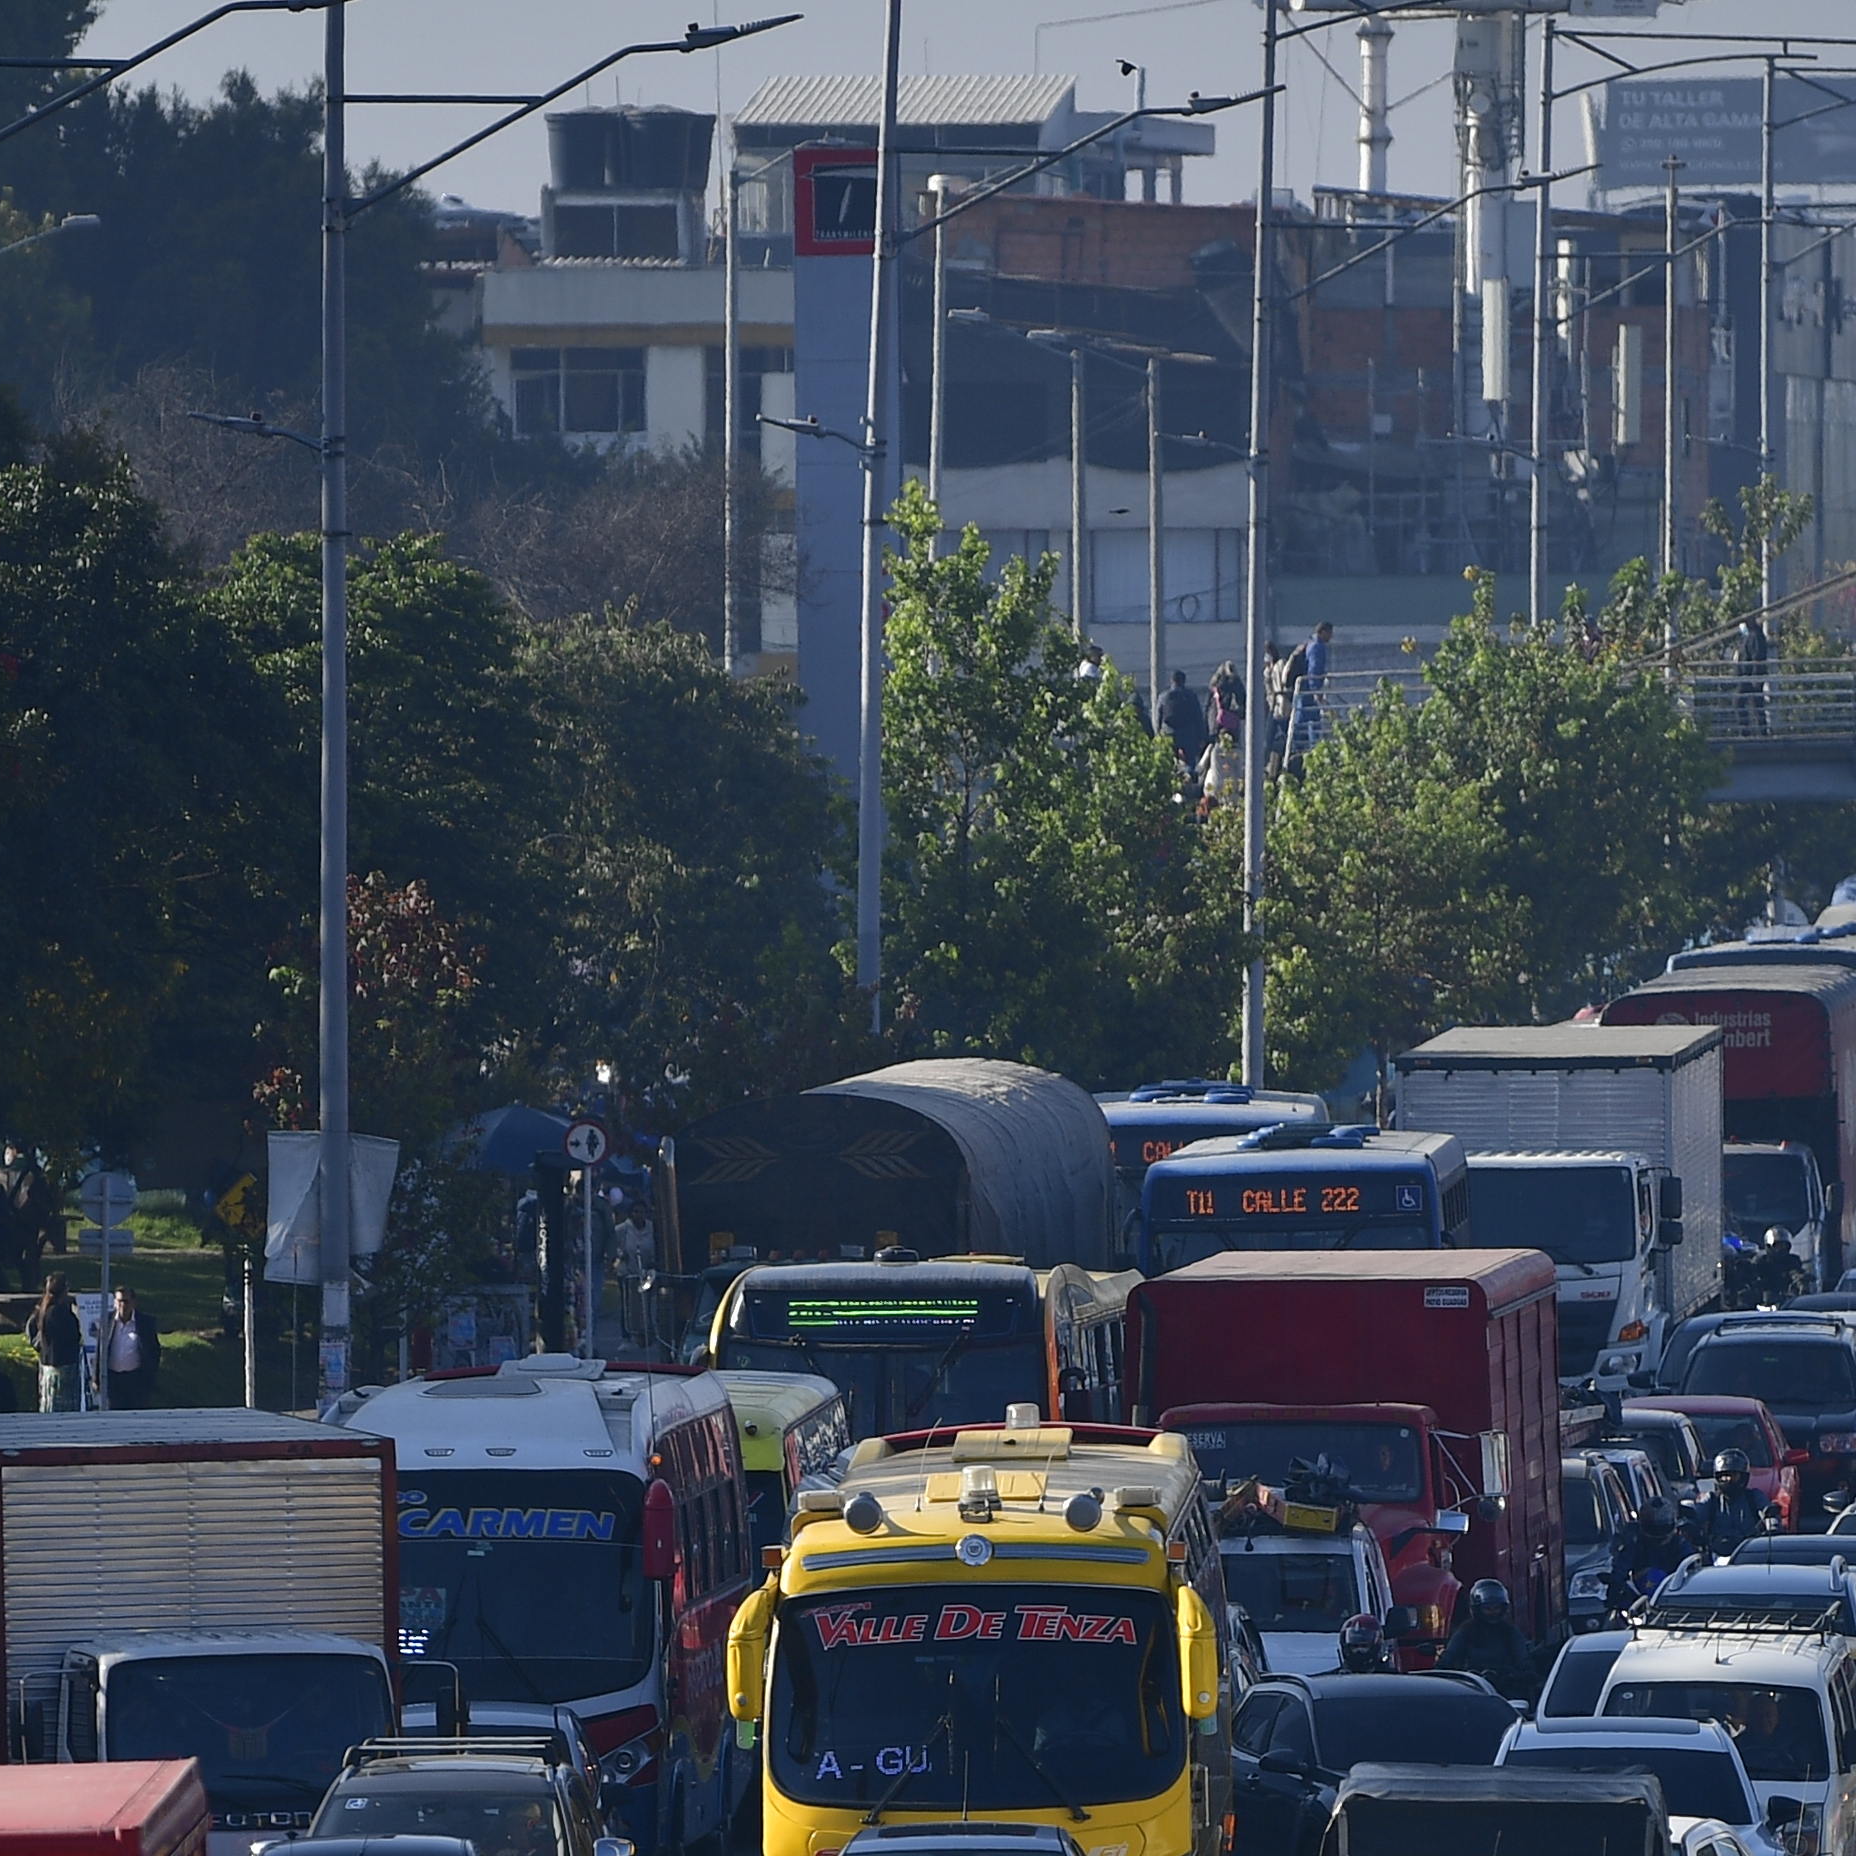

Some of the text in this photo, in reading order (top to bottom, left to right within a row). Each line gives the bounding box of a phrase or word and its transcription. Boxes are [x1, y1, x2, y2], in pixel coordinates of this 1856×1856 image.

[1695, 1011, 1772, 1027] Industrias
[1243, 1188, 1307, 1214] CALLE
[1321, 1186, 1360, 1213] 222
[1187, 1432, 1225, 1446] ESERVA
[397, 1508, 615, 1540] CARMEN
